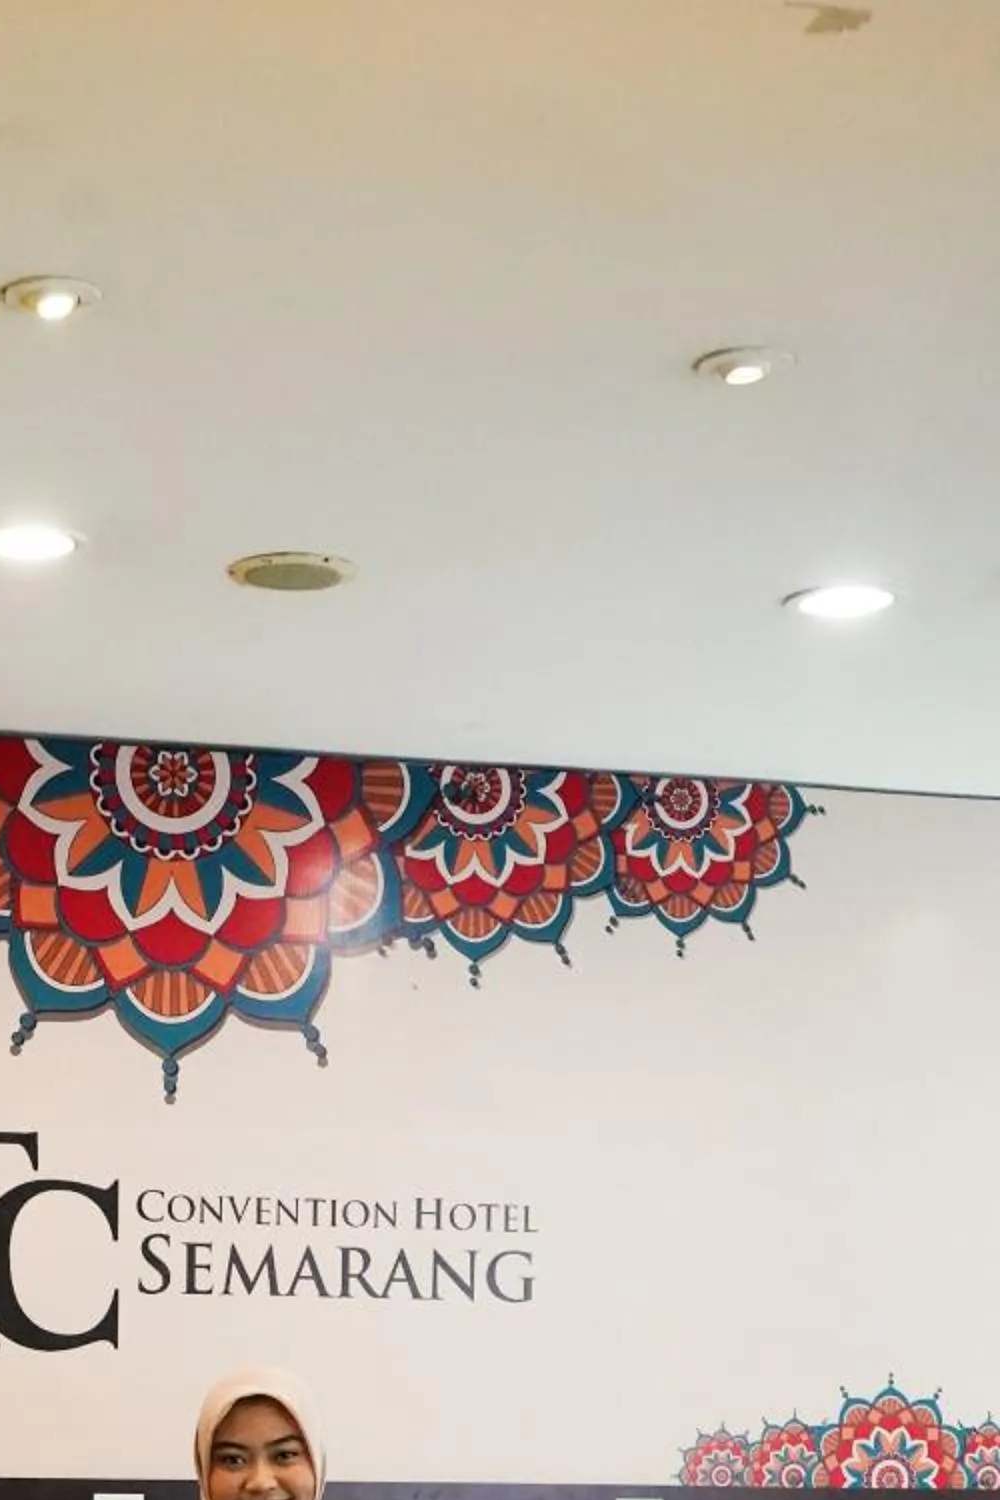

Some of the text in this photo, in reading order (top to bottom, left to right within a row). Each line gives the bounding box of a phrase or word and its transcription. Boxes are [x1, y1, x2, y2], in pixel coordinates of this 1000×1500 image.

[135, 1189, 538, 1233] CONVENTION HOTEL
[137, 1233, 534, 1303] SEMARANG
